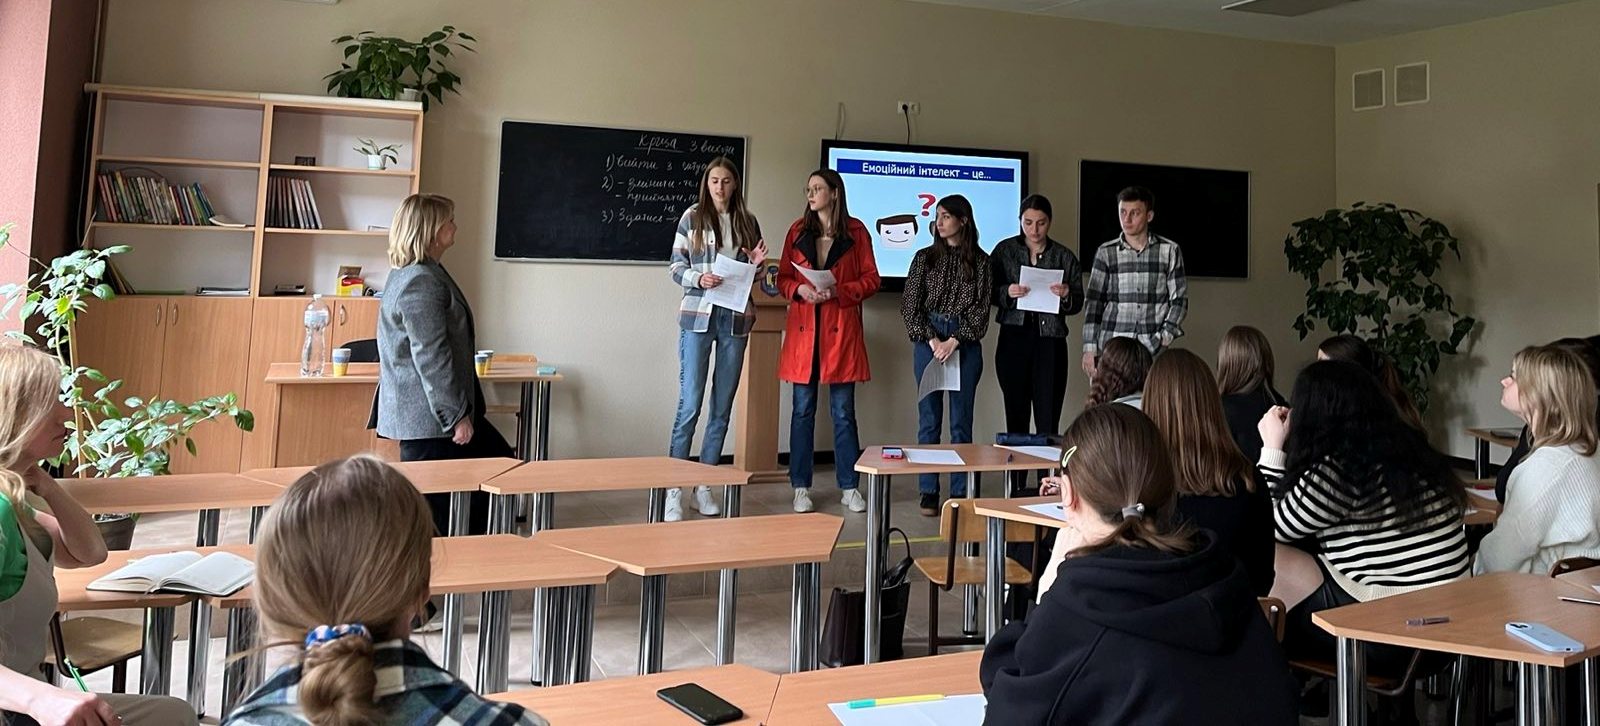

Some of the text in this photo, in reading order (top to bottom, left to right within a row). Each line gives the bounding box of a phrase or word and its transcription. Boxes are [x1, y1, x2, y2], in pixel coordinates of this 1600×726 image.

[606, 153, 615, 172] 1)
[862, 162, 915, 175] Емоційний
[918, 165, 960, 178] інтелект
[601, 174, 615, 192] 2)
[917, 193, 937, 217] ?
[601, 209, 614, 225] 3)
